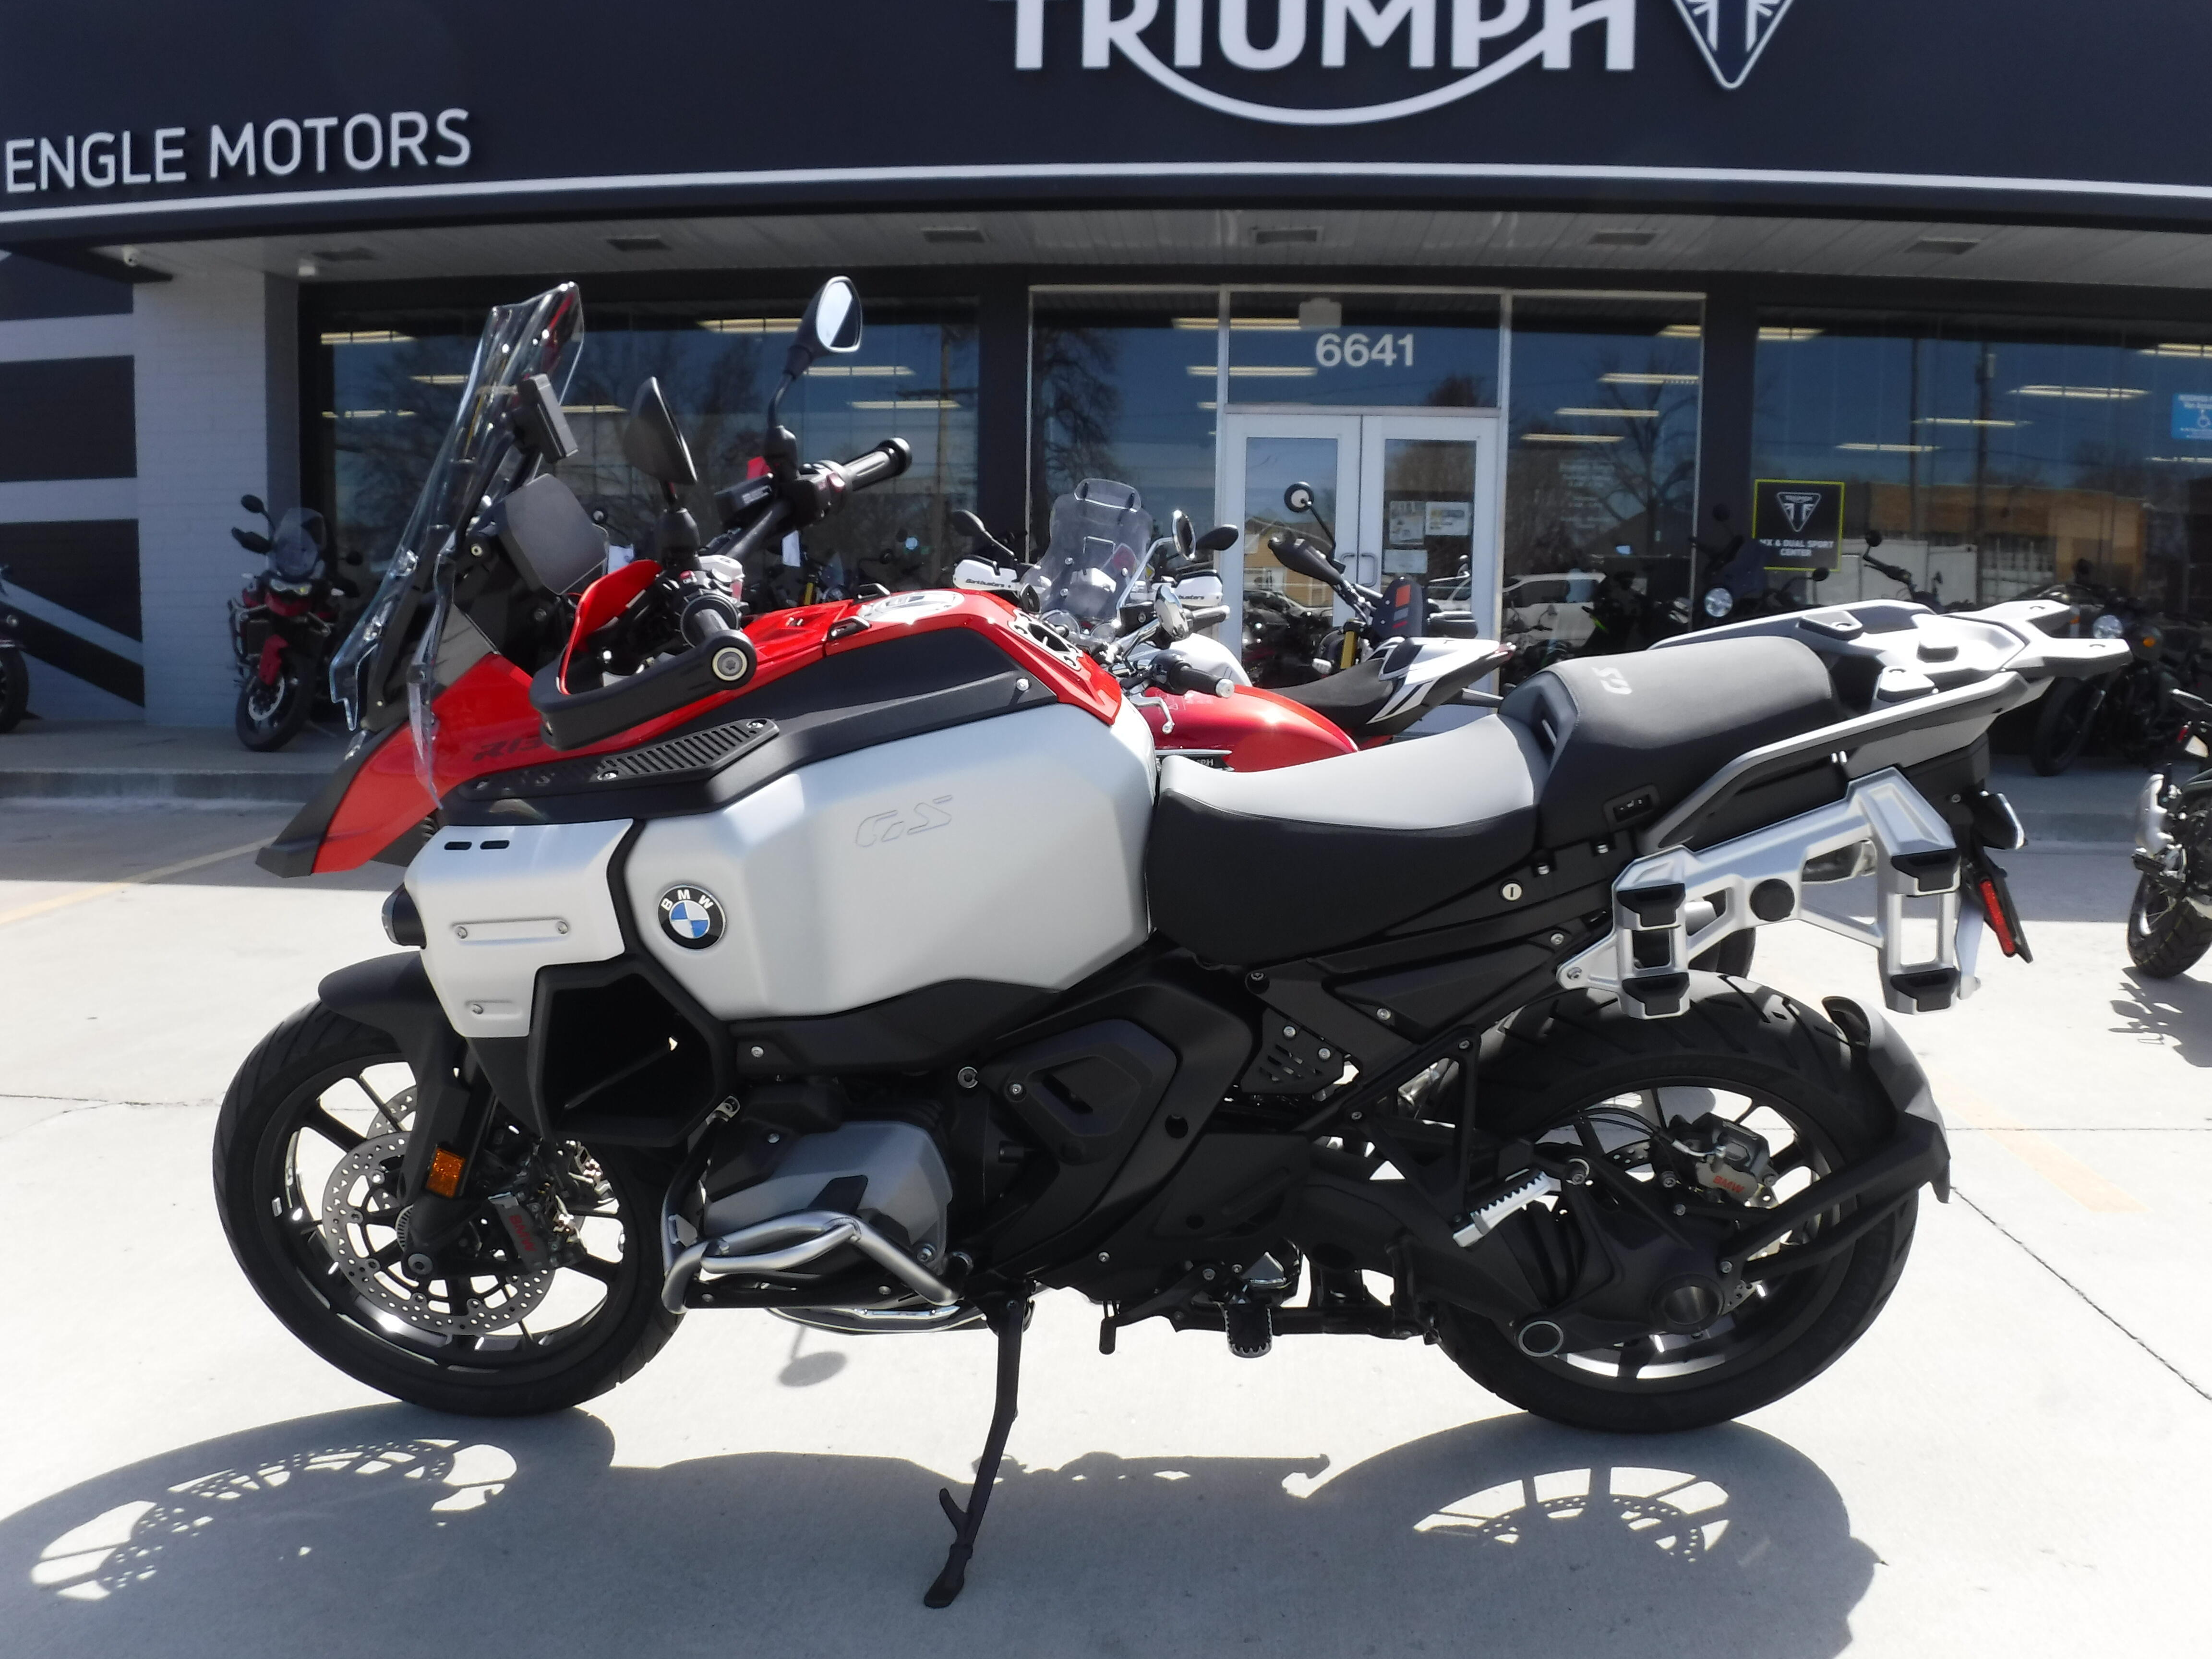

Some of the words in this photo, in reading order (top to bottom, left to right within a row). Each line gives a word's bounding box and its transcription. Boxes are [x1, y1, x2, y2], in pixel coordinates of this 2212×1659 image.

[990, 0, 1635, 124] TRIUMPH
[5, 127, 187, 193] ENGLE
[209, 108, 472, 179] MOTORS
[1315, 333, 1415, 367] 6641
[965, 578, 1005, 588] Barkbusters
[855, 794, 953, 848] GS
[661, 889, 714, 911] BMW
[1713, 1175, 1746, 1194] BMW
[508, 1214, 538, 1252] BMW
